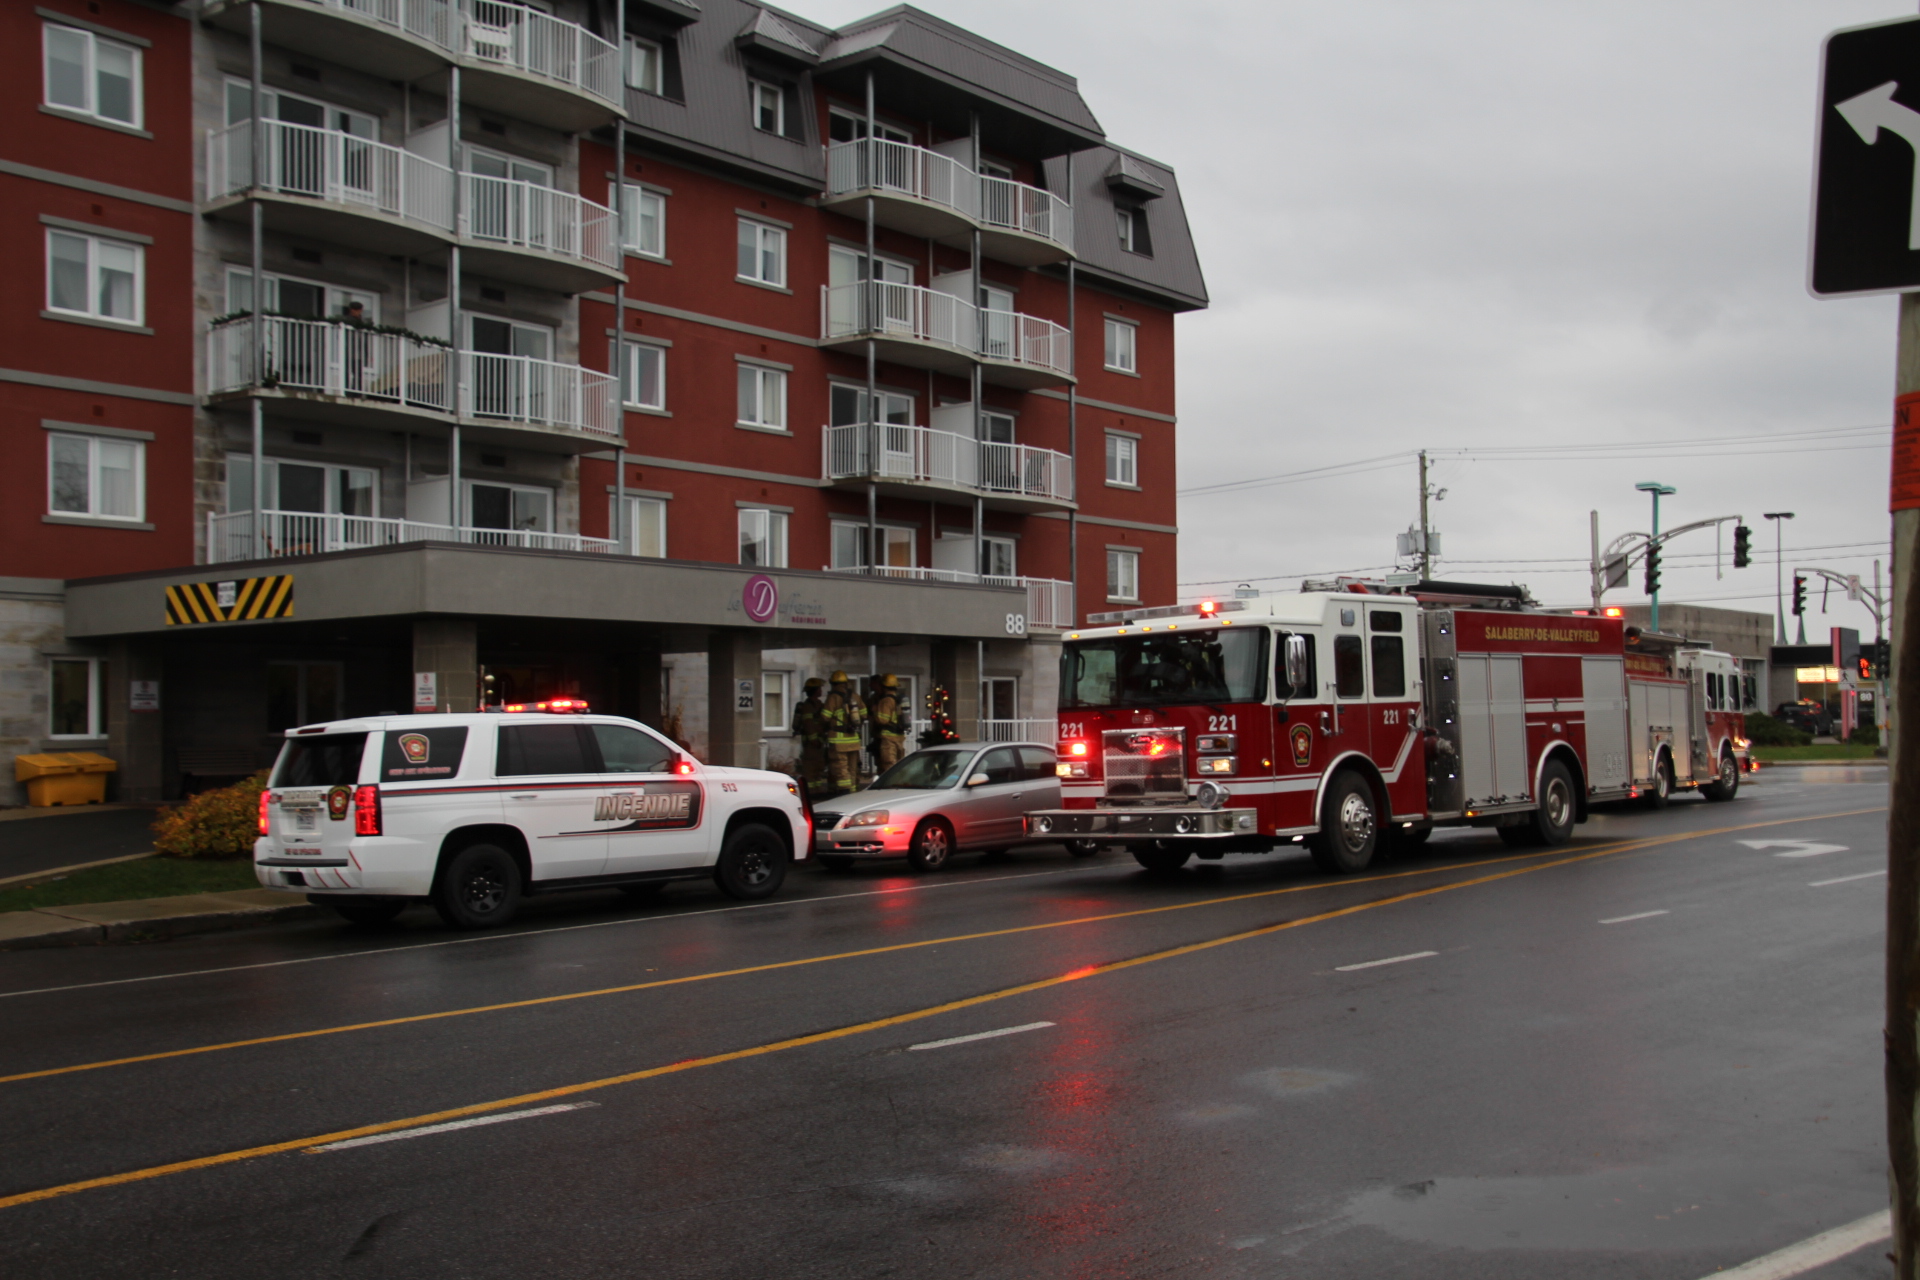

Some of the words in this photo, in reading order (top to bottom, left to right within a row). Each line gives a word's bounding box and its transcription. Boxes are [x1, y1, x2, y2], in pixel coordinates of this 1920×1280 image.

[1005, 613, 1025, 634] 88
[739, 696, 753, 707] 221
[1208, 714, 1237, 732] 221
[1383, 709, 1399, 725] 221
[1061, 722, 1084, 738] 221
[722, 783, 738, 792] 513
[594, 793, 691, 821] INCENDIE
